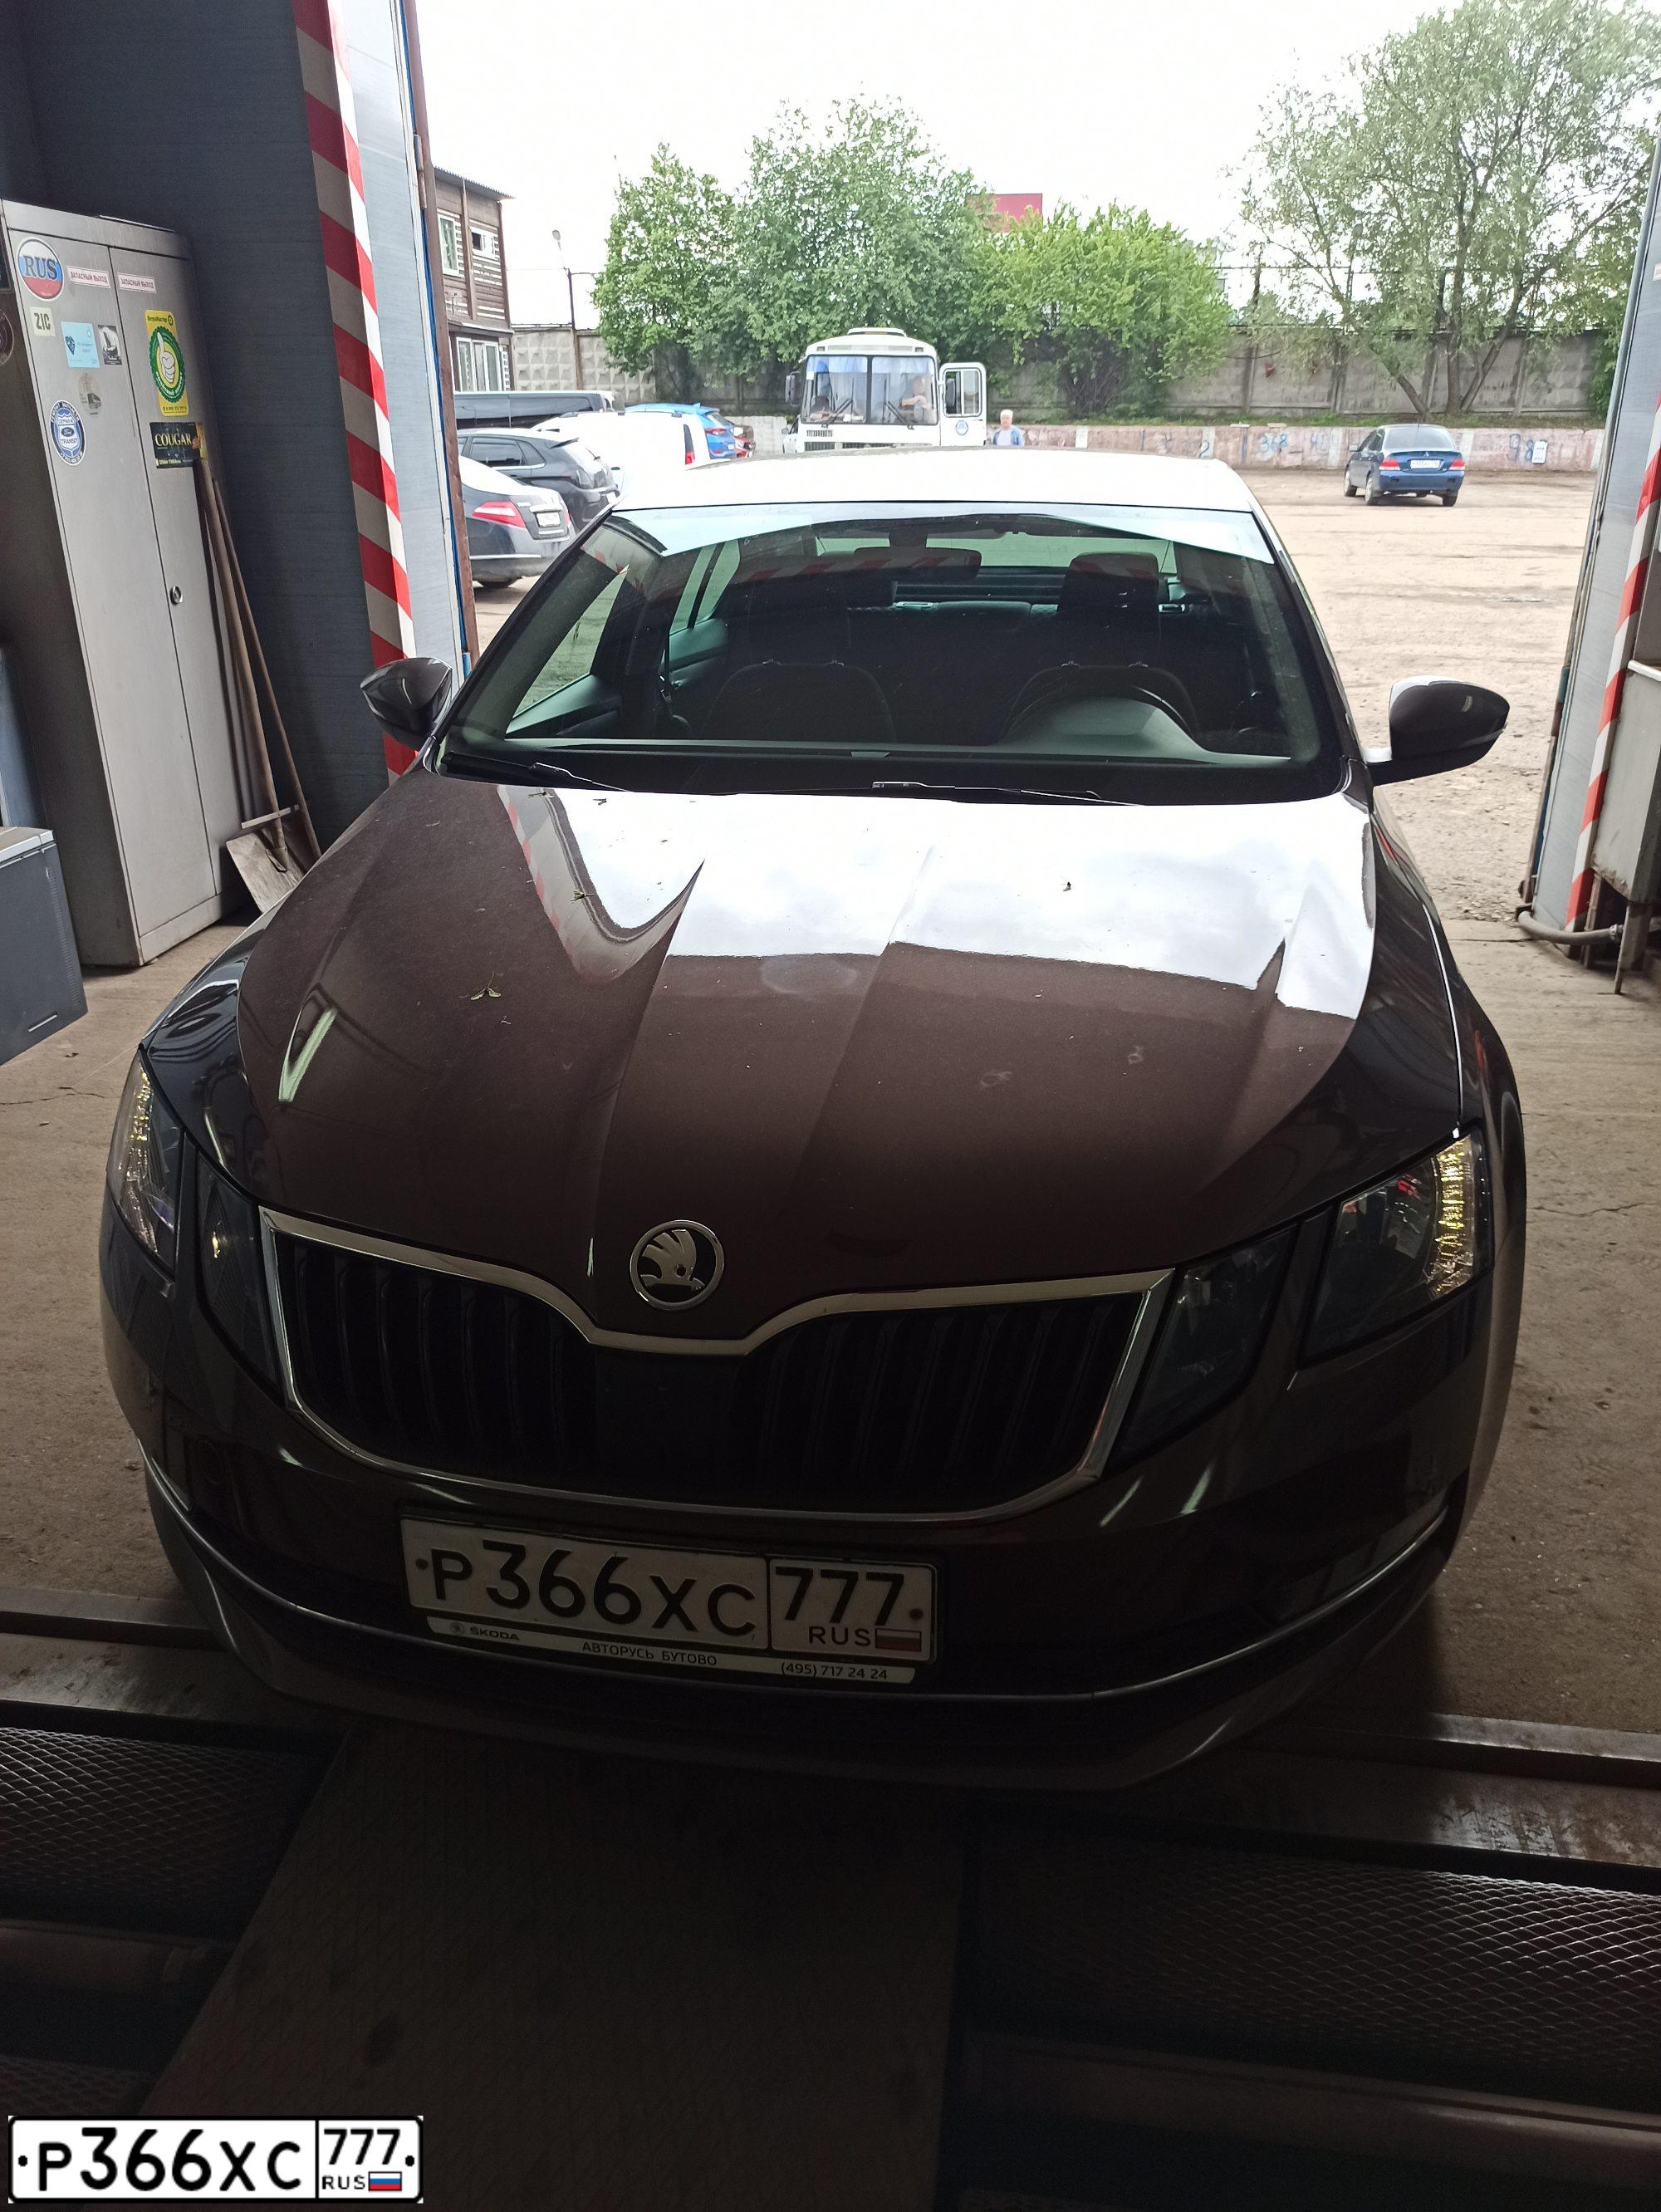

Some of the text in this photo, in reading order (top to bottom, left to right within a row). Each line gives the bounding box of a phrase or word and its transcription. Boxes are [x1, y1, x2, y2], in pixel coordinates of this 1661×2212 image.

[23, 256, 57, 279] RUS
[33, 312, 51, 330] ZIC
[154, 433, 192, 446] COUGAR
[431, 1539, 905, 1636] Р366ХС 777
[808, 1626, 872, 1646] RUS
[582, 1641, 888, 1680] АВТОРУСЬ БУТОВО (495) 717 24 24
